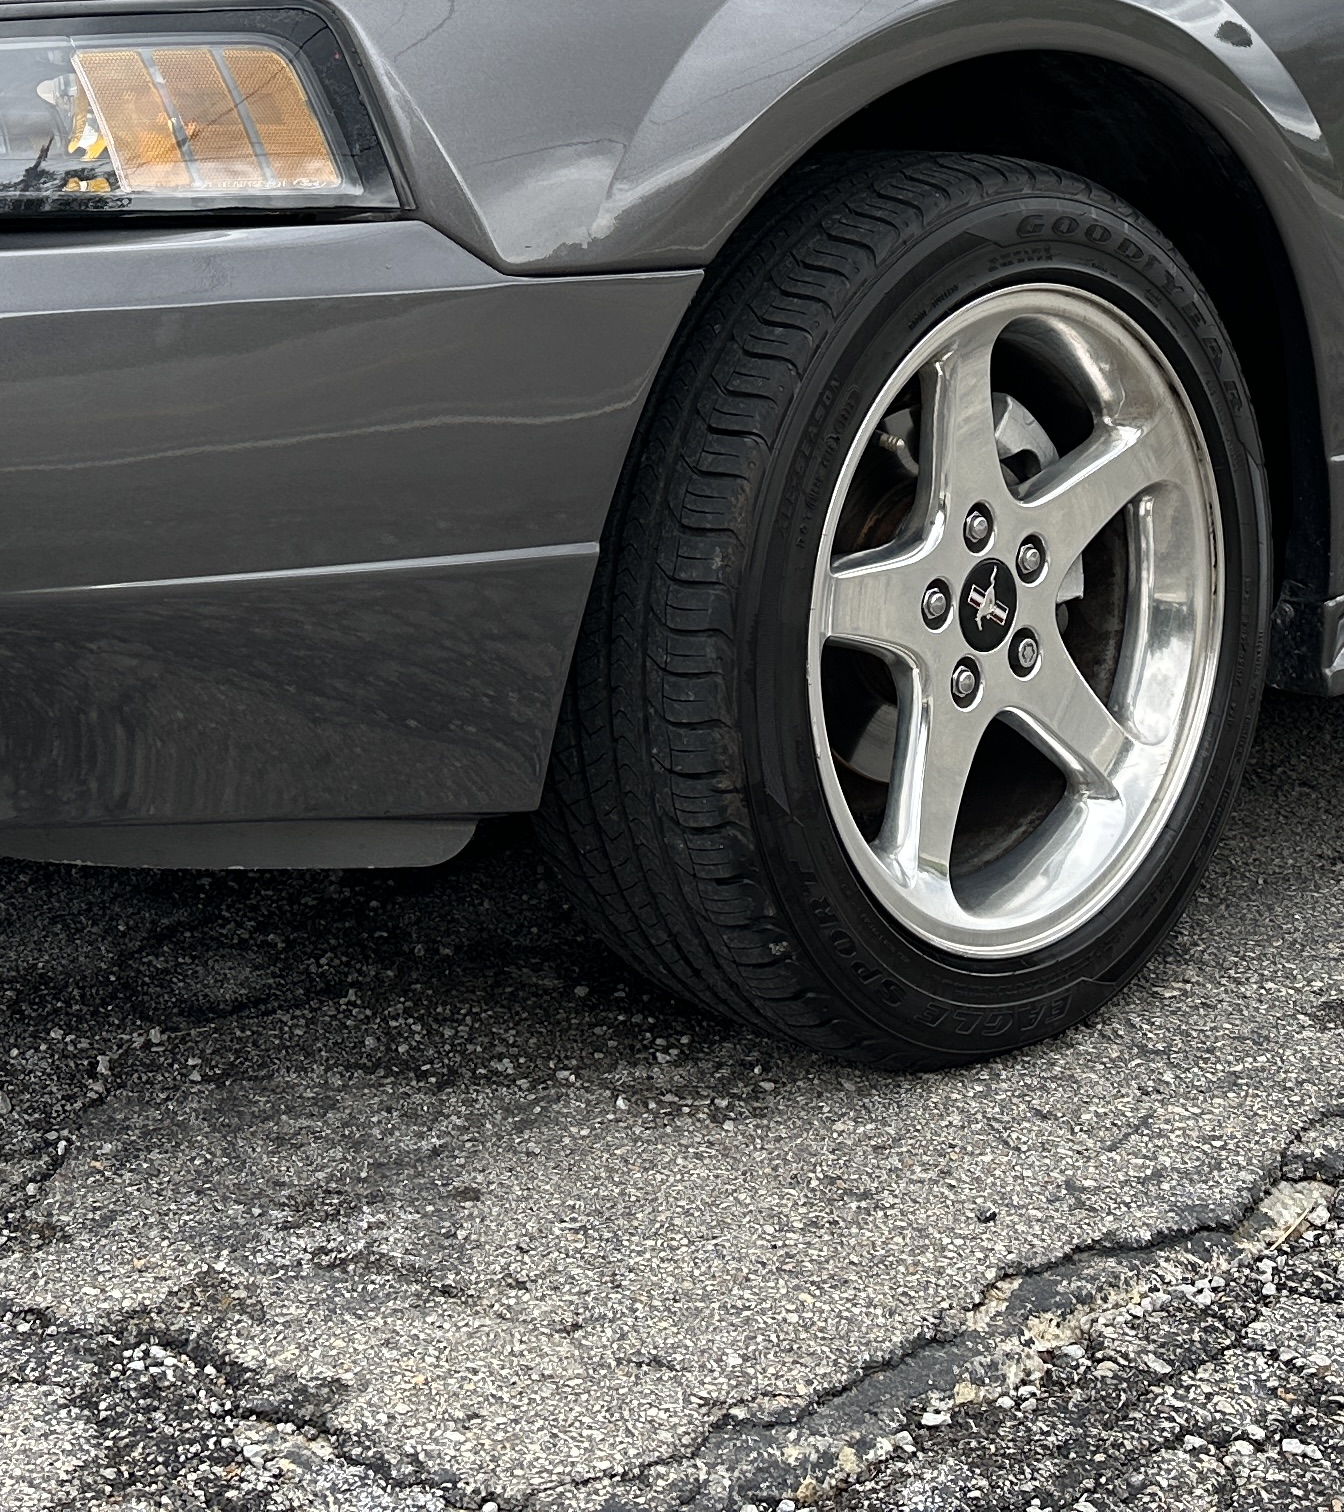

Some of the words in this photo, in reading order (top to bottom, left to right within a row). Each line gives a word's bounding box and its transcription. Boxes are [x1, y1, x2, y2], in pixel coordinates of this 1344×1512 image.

[1015, 213, 1244, 413] GOODYEAR
[788, 858, 907, 1008] SPORT
[913, 991, 1073, 1038] EAGLE
